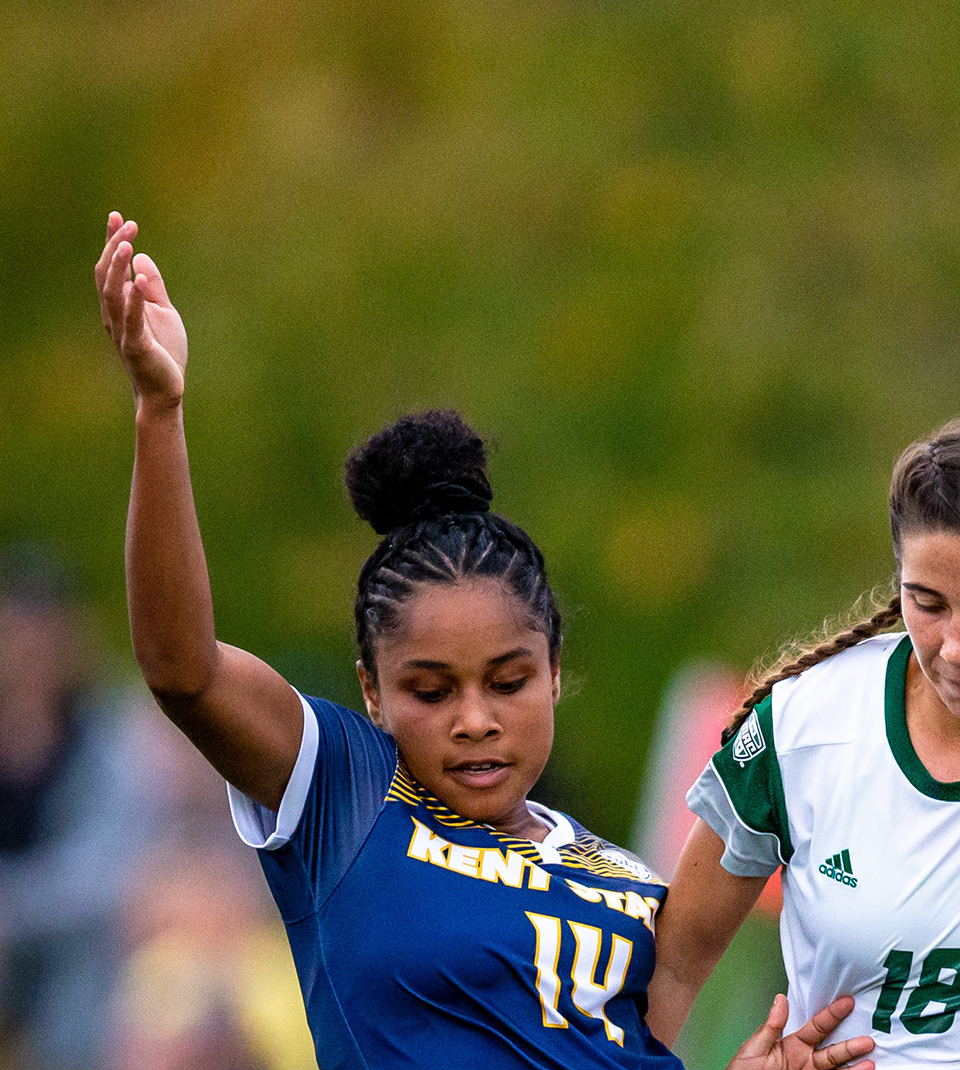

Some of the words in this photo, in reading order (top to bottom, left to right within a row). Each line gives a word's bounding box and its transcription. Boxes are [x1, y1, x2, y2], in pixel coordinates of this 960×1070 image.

[406, 815, 553, 892] KENT
[565, 879, 660, 939] STA
[818, 864, 858, 888] adidas
[524, 911, 634, 1049] 14
